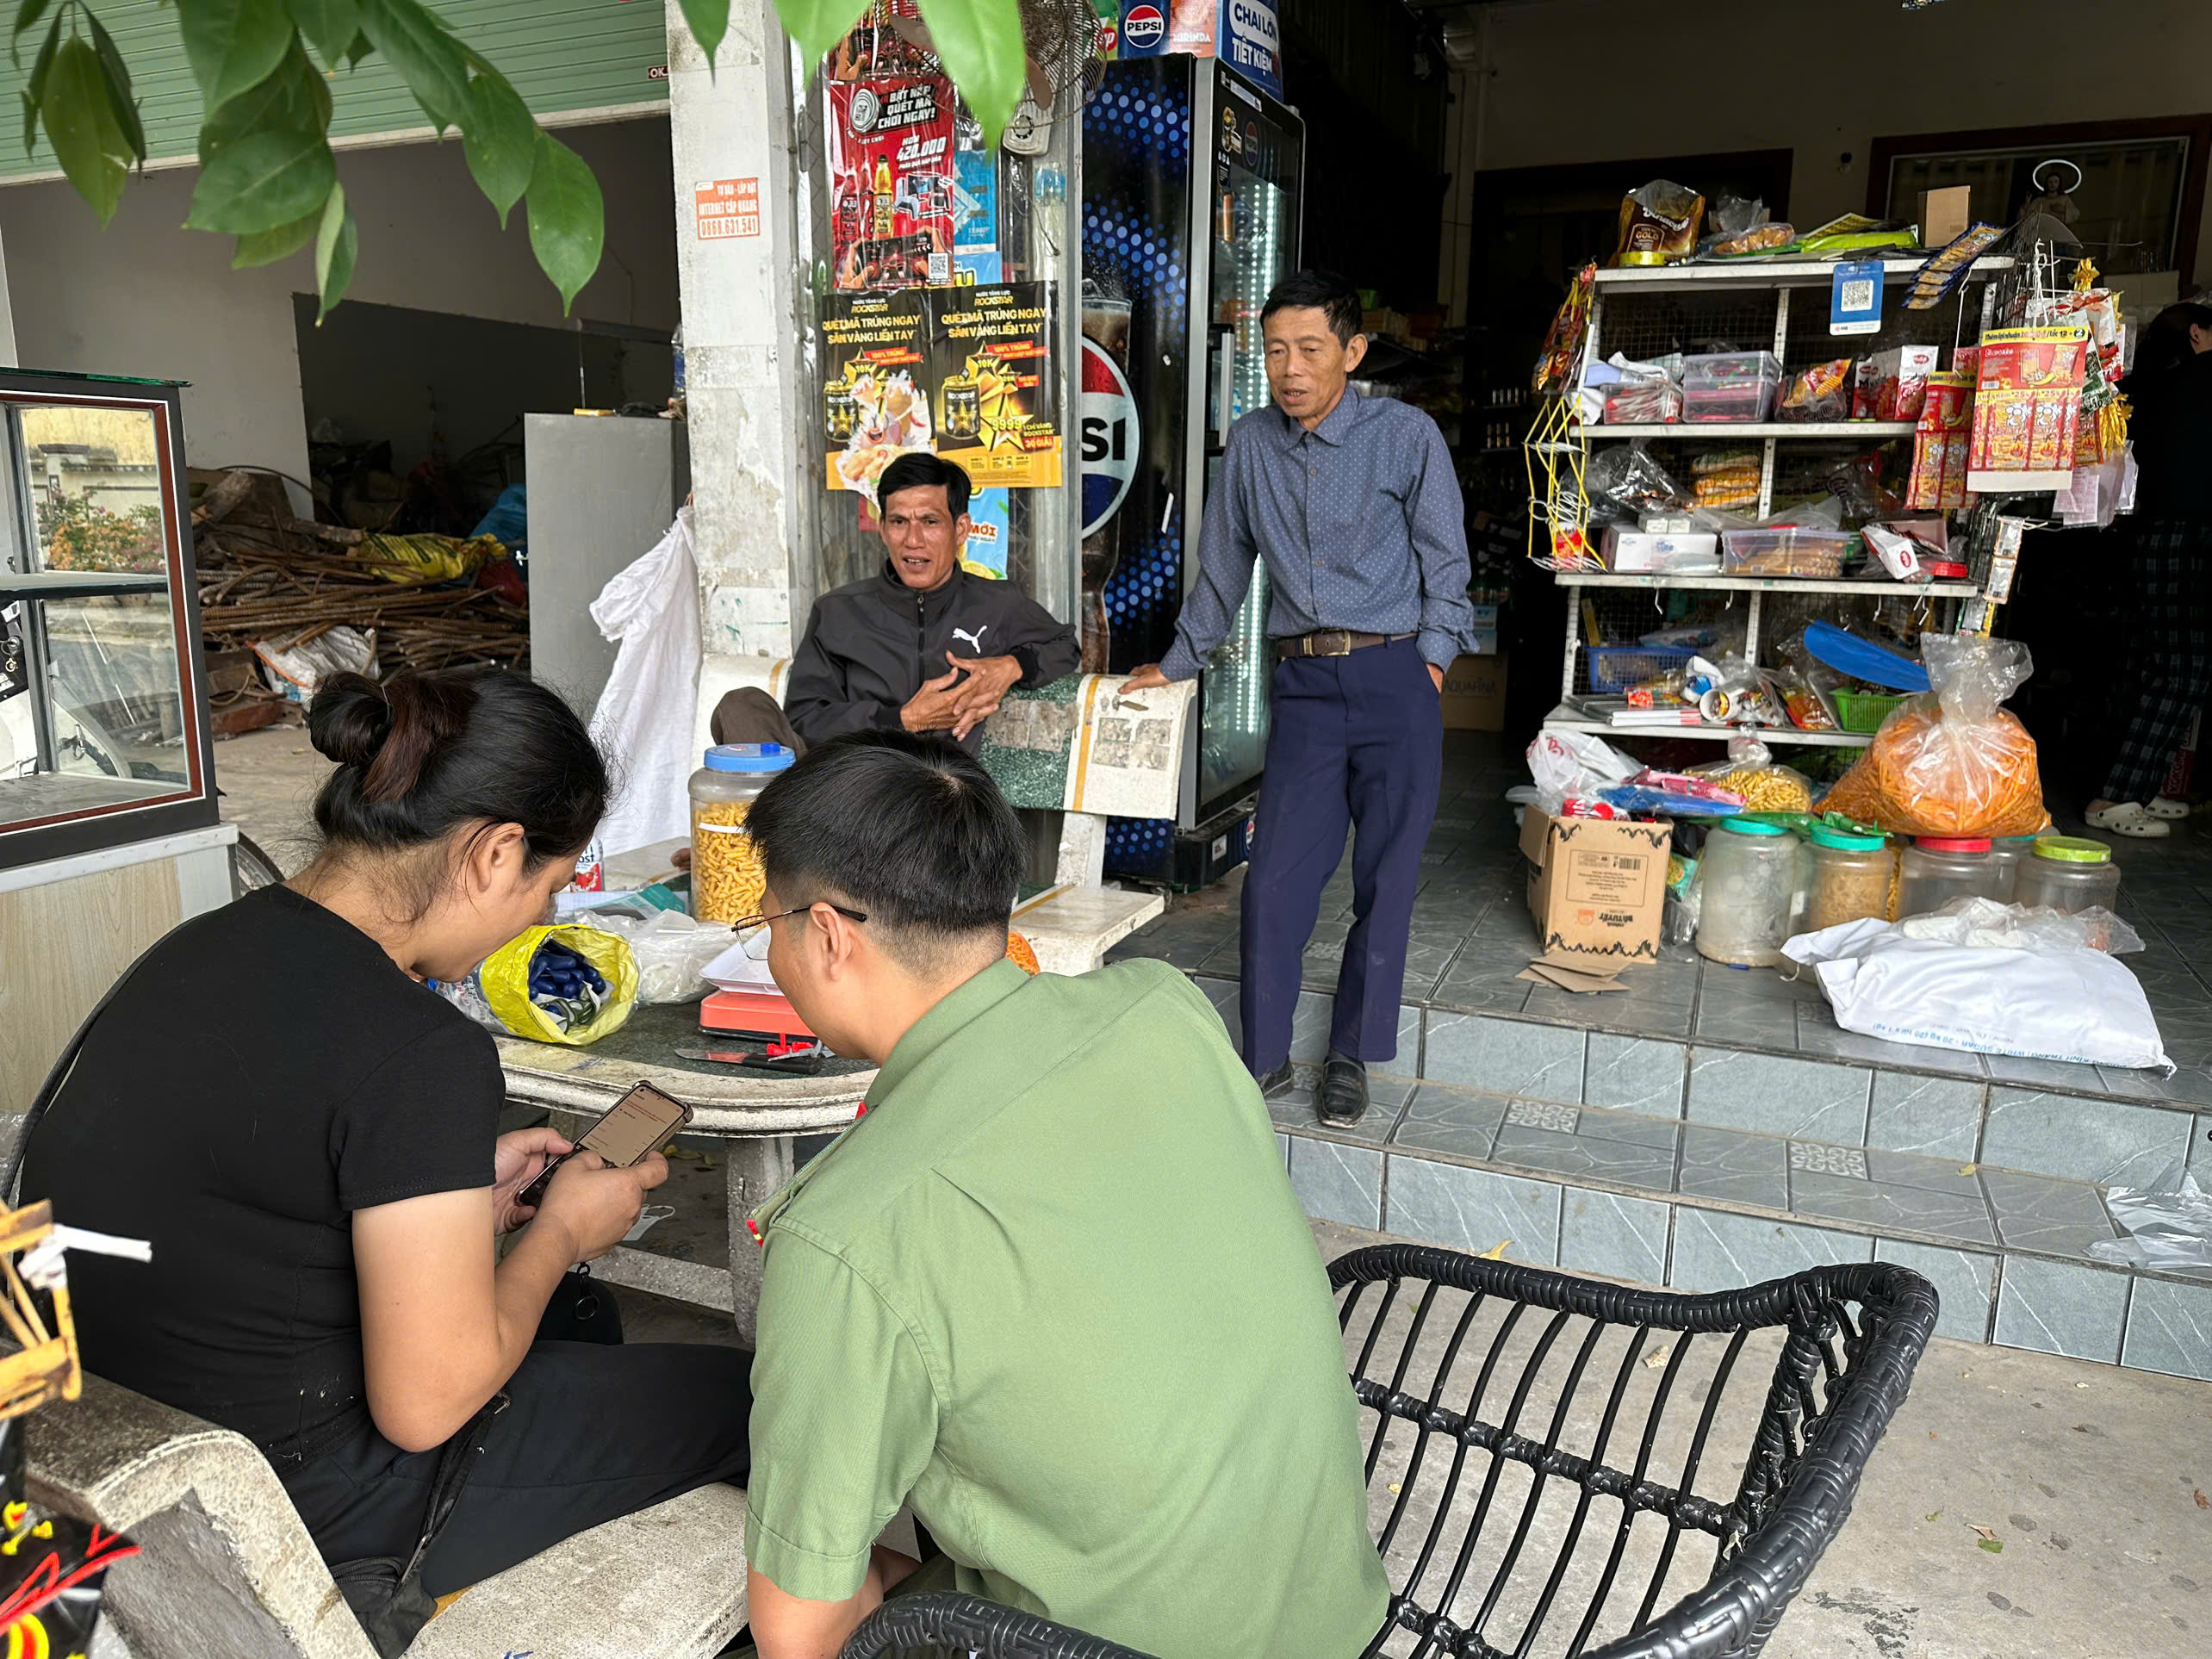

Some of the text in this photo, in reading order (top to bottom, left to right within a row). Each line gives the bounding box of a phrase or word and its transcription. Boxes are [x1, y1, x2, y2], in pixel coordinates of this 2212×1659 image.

[1234, 3, 1261, 32] CHAI
[1127, 22, 1162, 32] PEPSI
[1172, 32, 1211, 43] MIRINDA
[1232, 32, 1252, 65] TIẾT
[878, 108, 935, 129] CHƠI NGAY!
[897, 136, 947, 161] 420.000
[1636, 232, 1659, 240] GOLD
[974, 295, 1014, 306] ROCKSTAR
[851, 303, 889, 314] ROCKSTAR
[1018, 308, 1047, 319] NGAY
[893, 315, 921, 326] NGAY
[969, 324, 997, 337] VÀNG
[1019, 323, 1041, 333] TAY
[2075, 328, 2083, 337] 2
[847, 331, 873, 343] VÀNG
[894, 330, 914, 340] TAY
[991, 419, 1022, 431] 9999
[971, 523, 996, 537] MỚI
[1961, 1040, 1992, 1053] SUGAR
